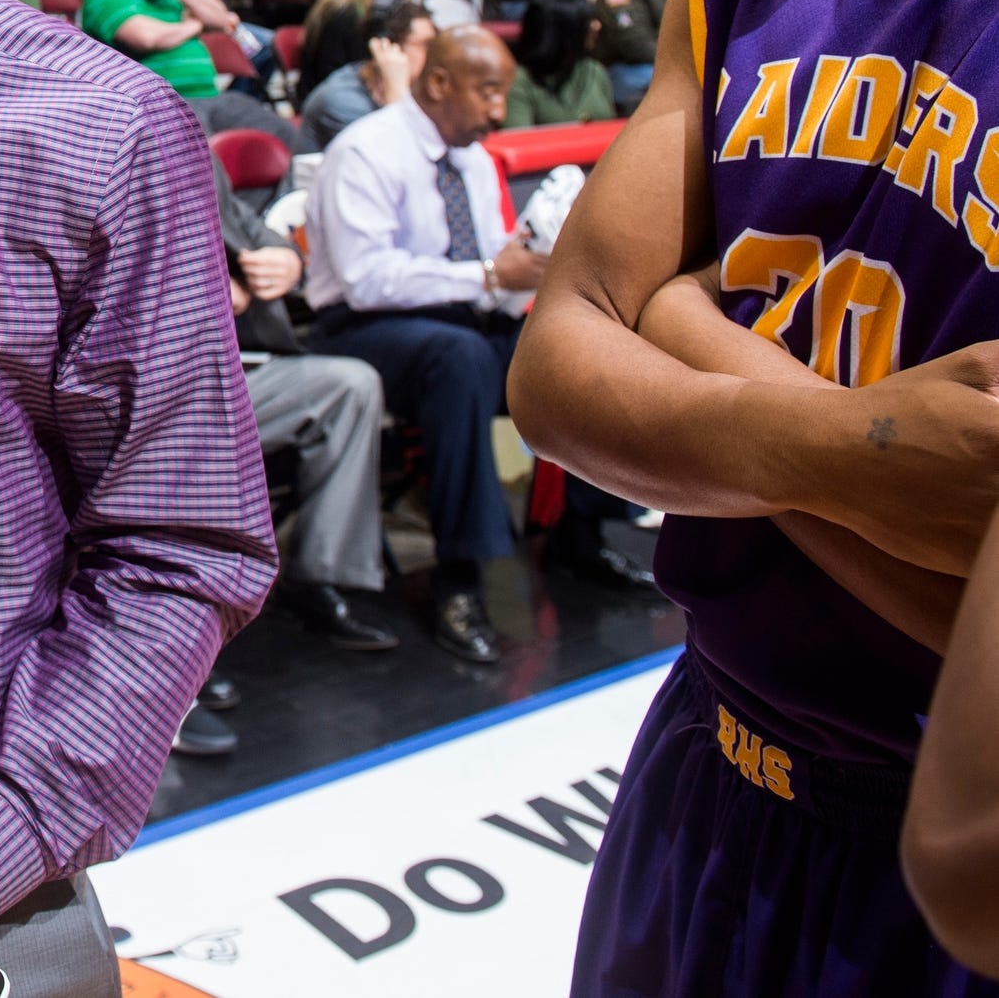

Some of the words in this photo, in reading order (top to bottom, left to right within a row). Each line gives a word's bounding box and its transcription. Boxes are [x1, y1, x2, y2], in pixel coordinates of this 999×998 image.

[713, 53, 999, 272] AIDERS
[721, 227, 906, 389] 20
[480, 767, 624, 866] W
